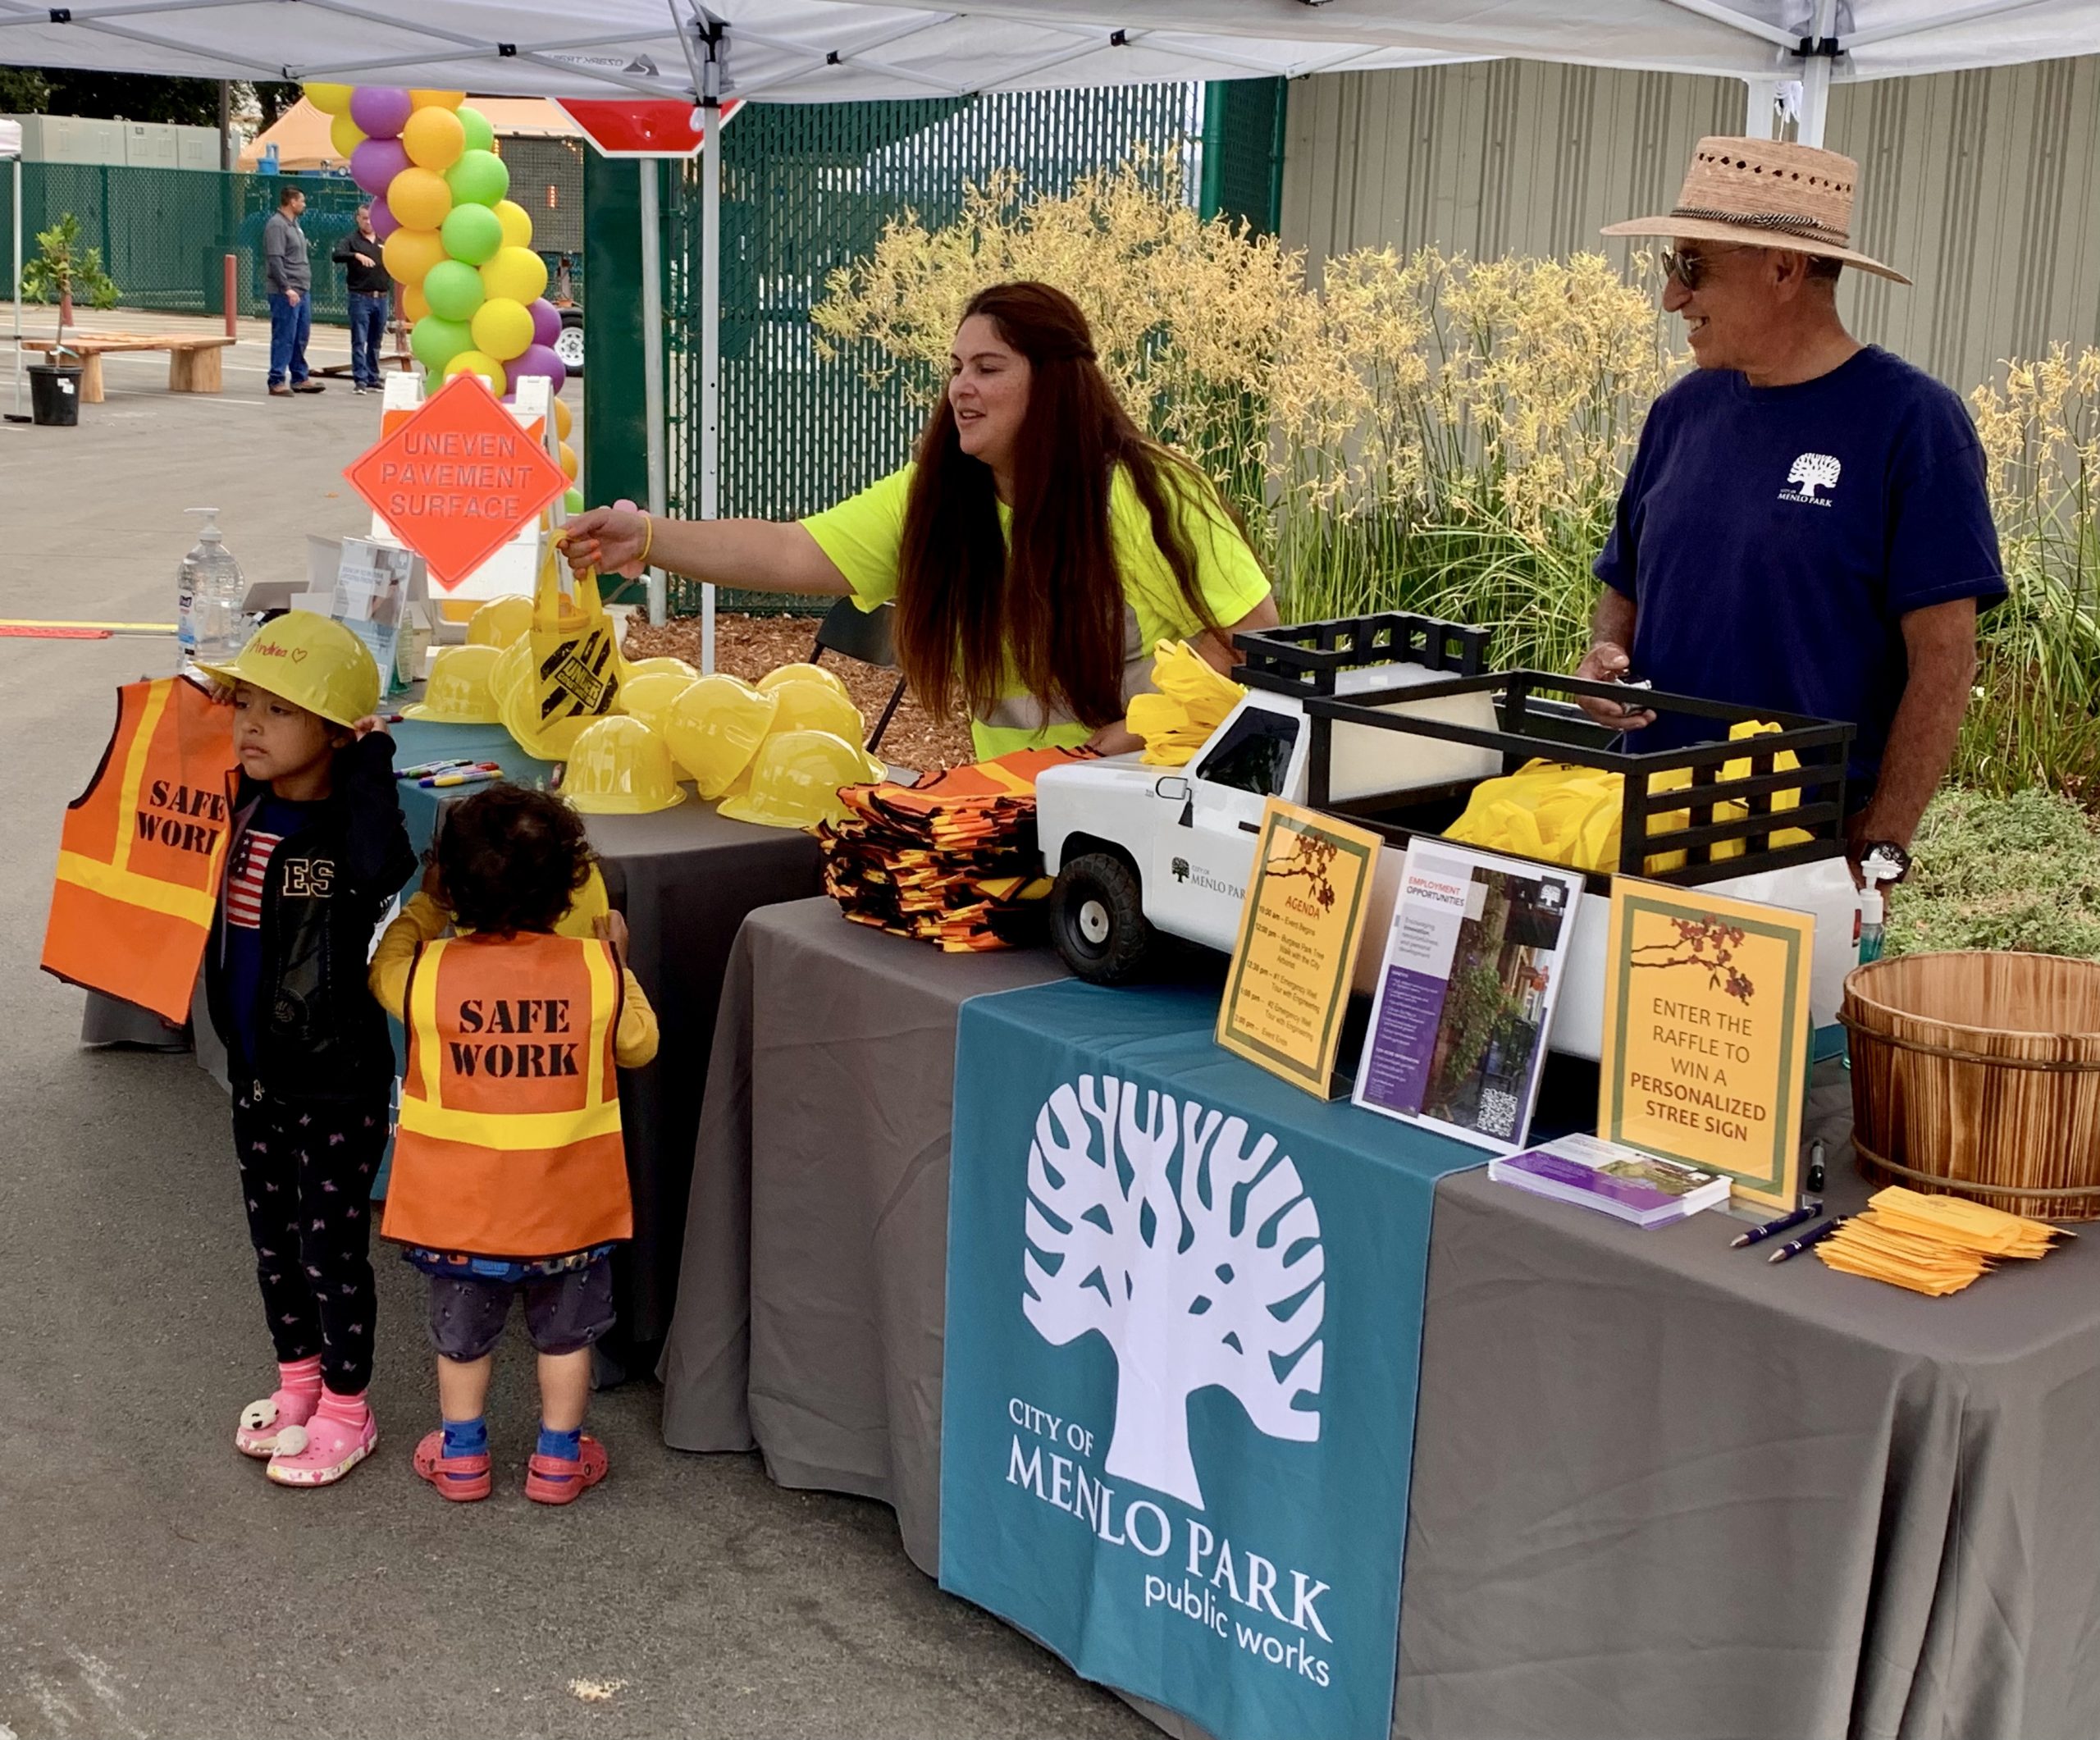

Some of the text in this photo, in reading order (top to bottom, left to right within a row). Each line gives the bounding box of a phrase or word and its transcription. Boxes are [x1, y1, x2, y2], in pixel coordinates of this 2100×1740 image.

[404, 432, 516, 459] UNEVEN
[381, 463, 533, 488] PAVEMENT
[390, 494, 521, 519] SURFACE
[1777, 493, 1833, 507] MENLO PARK
[563, 659, 601, 700] UNDER
[149, 779, 226, 823] SAFE
[283, 858, 336, 897] ES
[1190, 873, 1246, 900] MENLO PAR
[1408, 876, 1461, 895] EMPLOYMENT
[1285, 895, 1321, 920] AGENDA
[1406, 886, 1464, 907] OPPORTUNITIES
[459, 999, 570, 1034] SAFE
[1652, 998, 1752, 1036] ENTER THE
[449, 1041, 579, 1078] WORK
[1653, 1025, 1750, 1063] RAFFLE TO
[1671, 1056, 1727, 1087] WIN A
[1631, 1071, 1766, 1121] PERSONALIZED
[1646, 1099, 1748, 1142] STREE SIGN
[1008, 1397, 1094, 1457] CITY OF
[1006, 1434, 1334, 1643] MENLO PARK
[1145, 1573, 1331, 1687] public works
